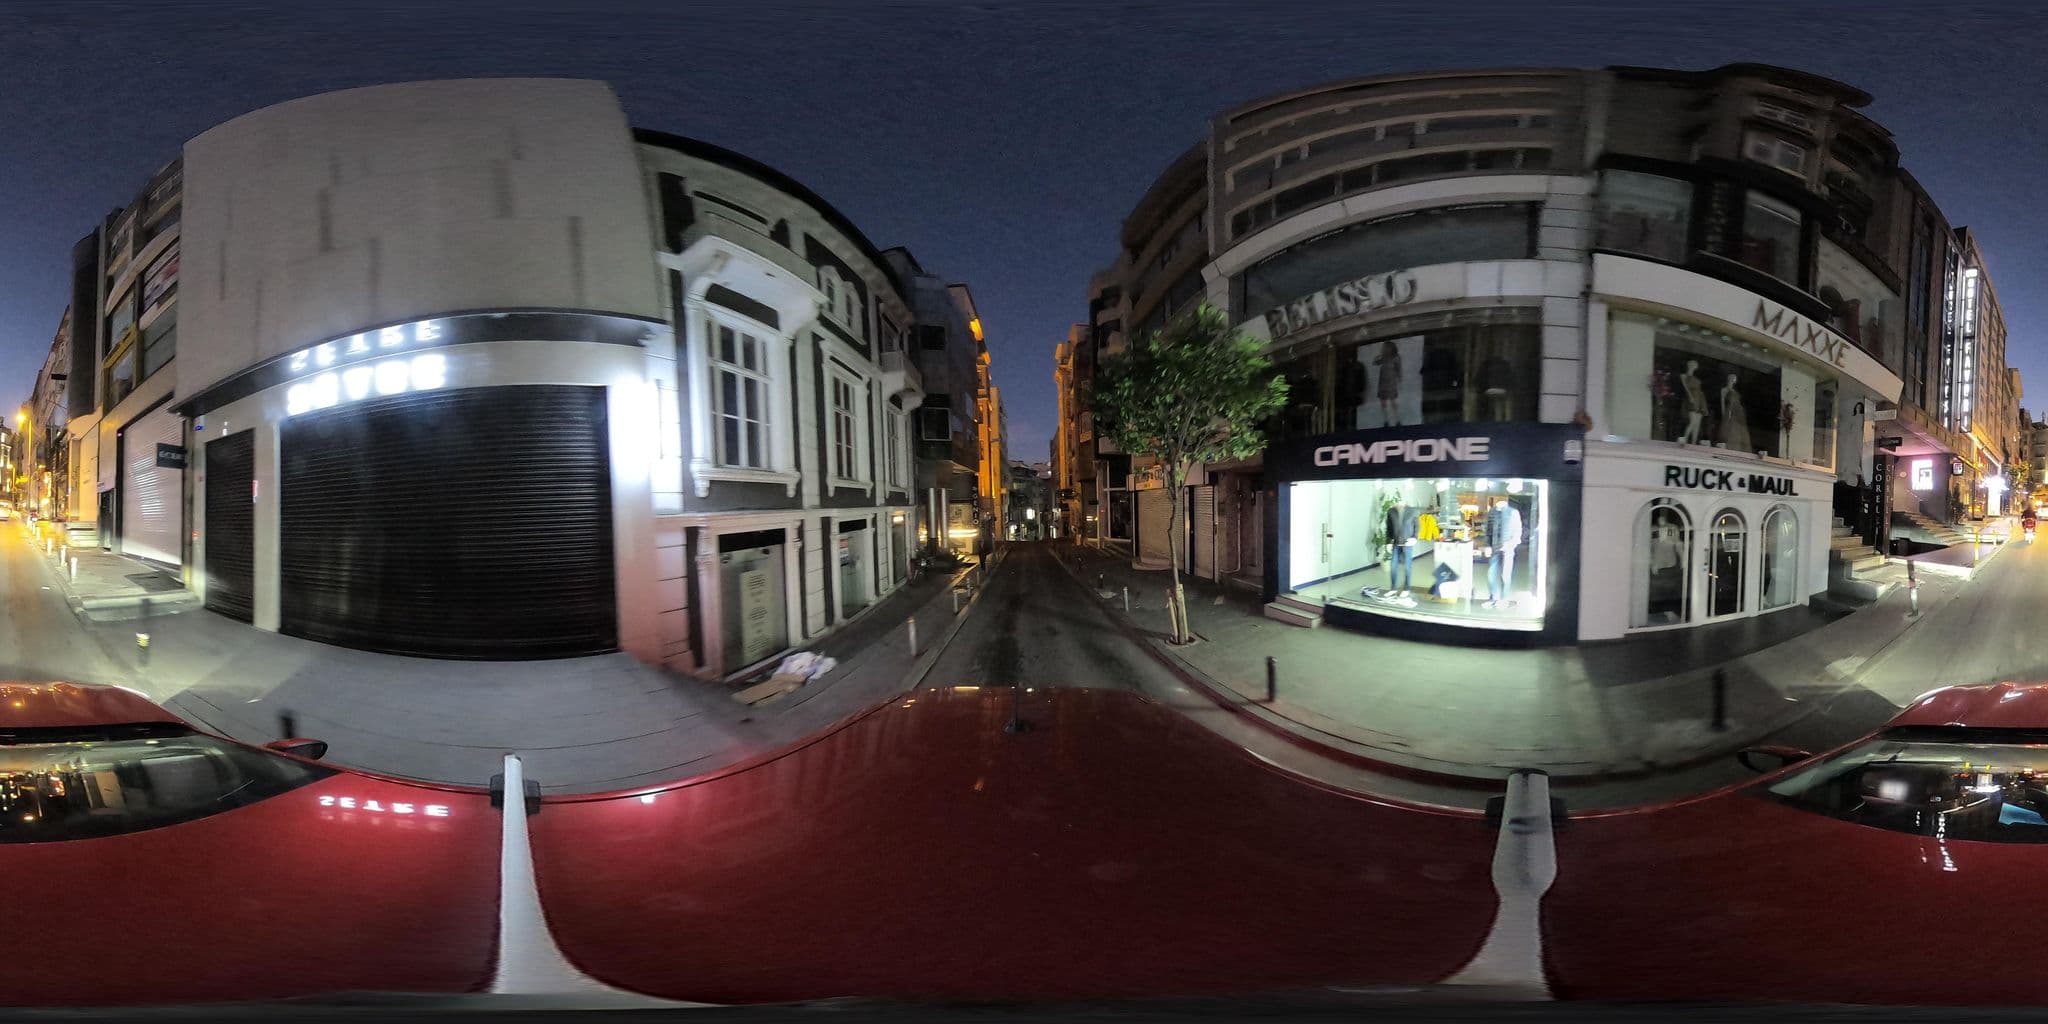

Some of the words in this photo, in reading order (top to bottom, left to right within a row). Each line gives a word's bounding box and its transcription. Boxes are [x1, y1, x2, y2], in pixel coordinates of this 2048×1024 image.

[1752, 299, 1850, 368] MAXXE
[1314, 437, 1490, 467] CAMPIONE
[1664, 465, 1734, 491] RUCK
[1748, 474, 1798, 496] MAUL
